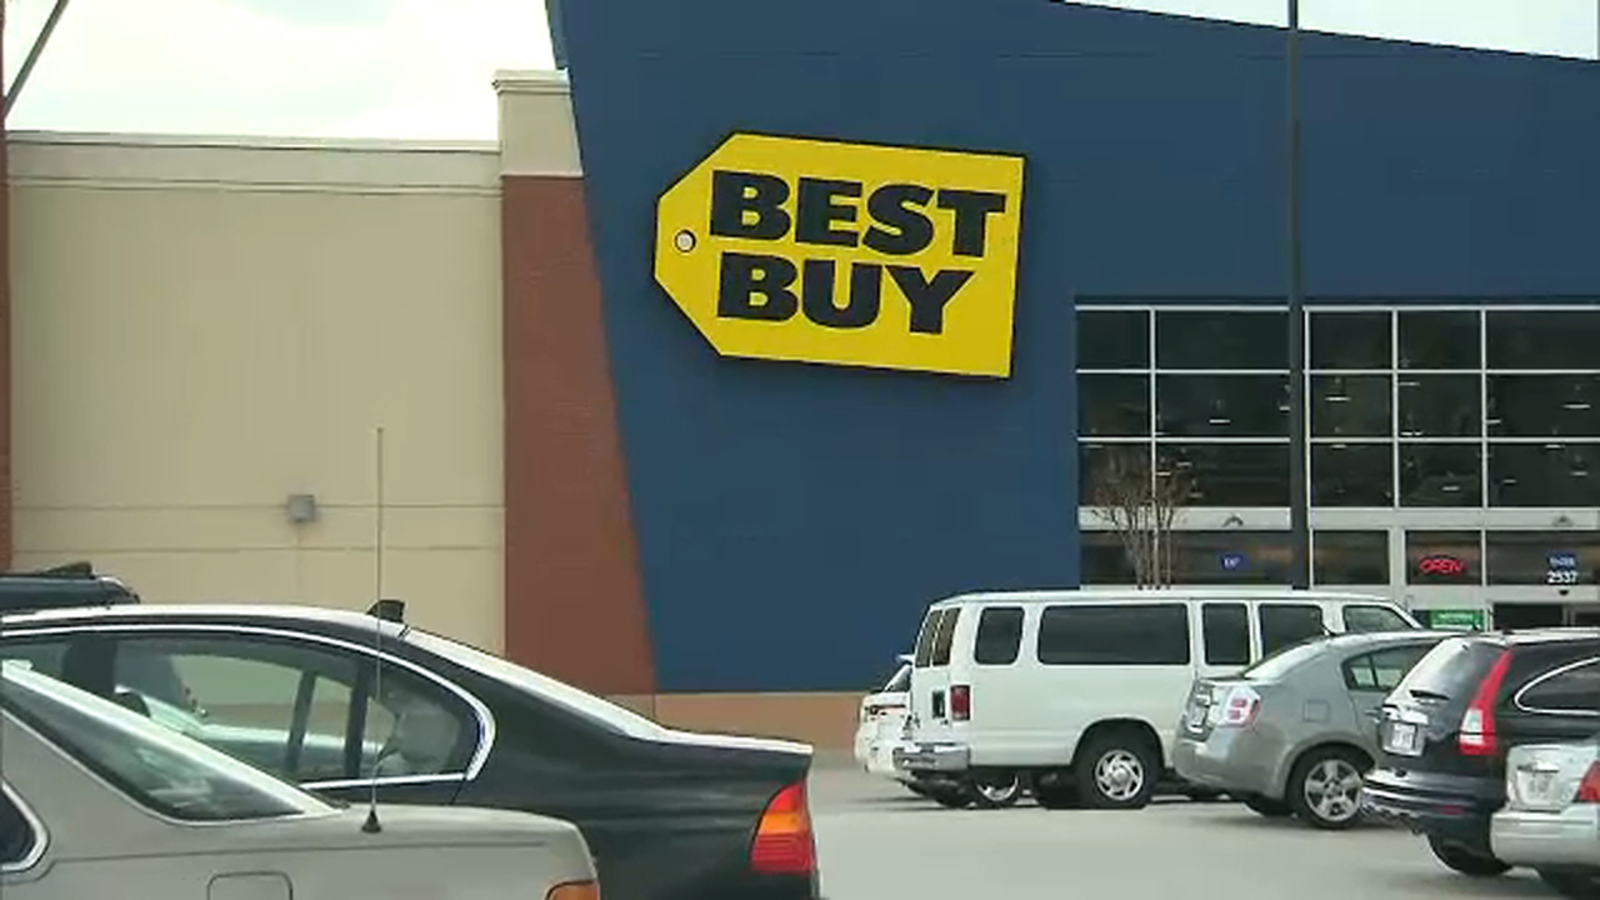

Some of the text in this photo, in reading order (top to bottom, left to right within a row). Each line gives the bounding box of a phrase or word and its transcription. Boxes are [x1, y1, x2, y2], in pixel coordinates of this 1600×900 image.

[709, 169, 1006, 258] BEST
[717, 251, 975, 335] BUY
[1419, 558, 1464, 574] OPEN
[1547, 570, 1578, 584] 2537
